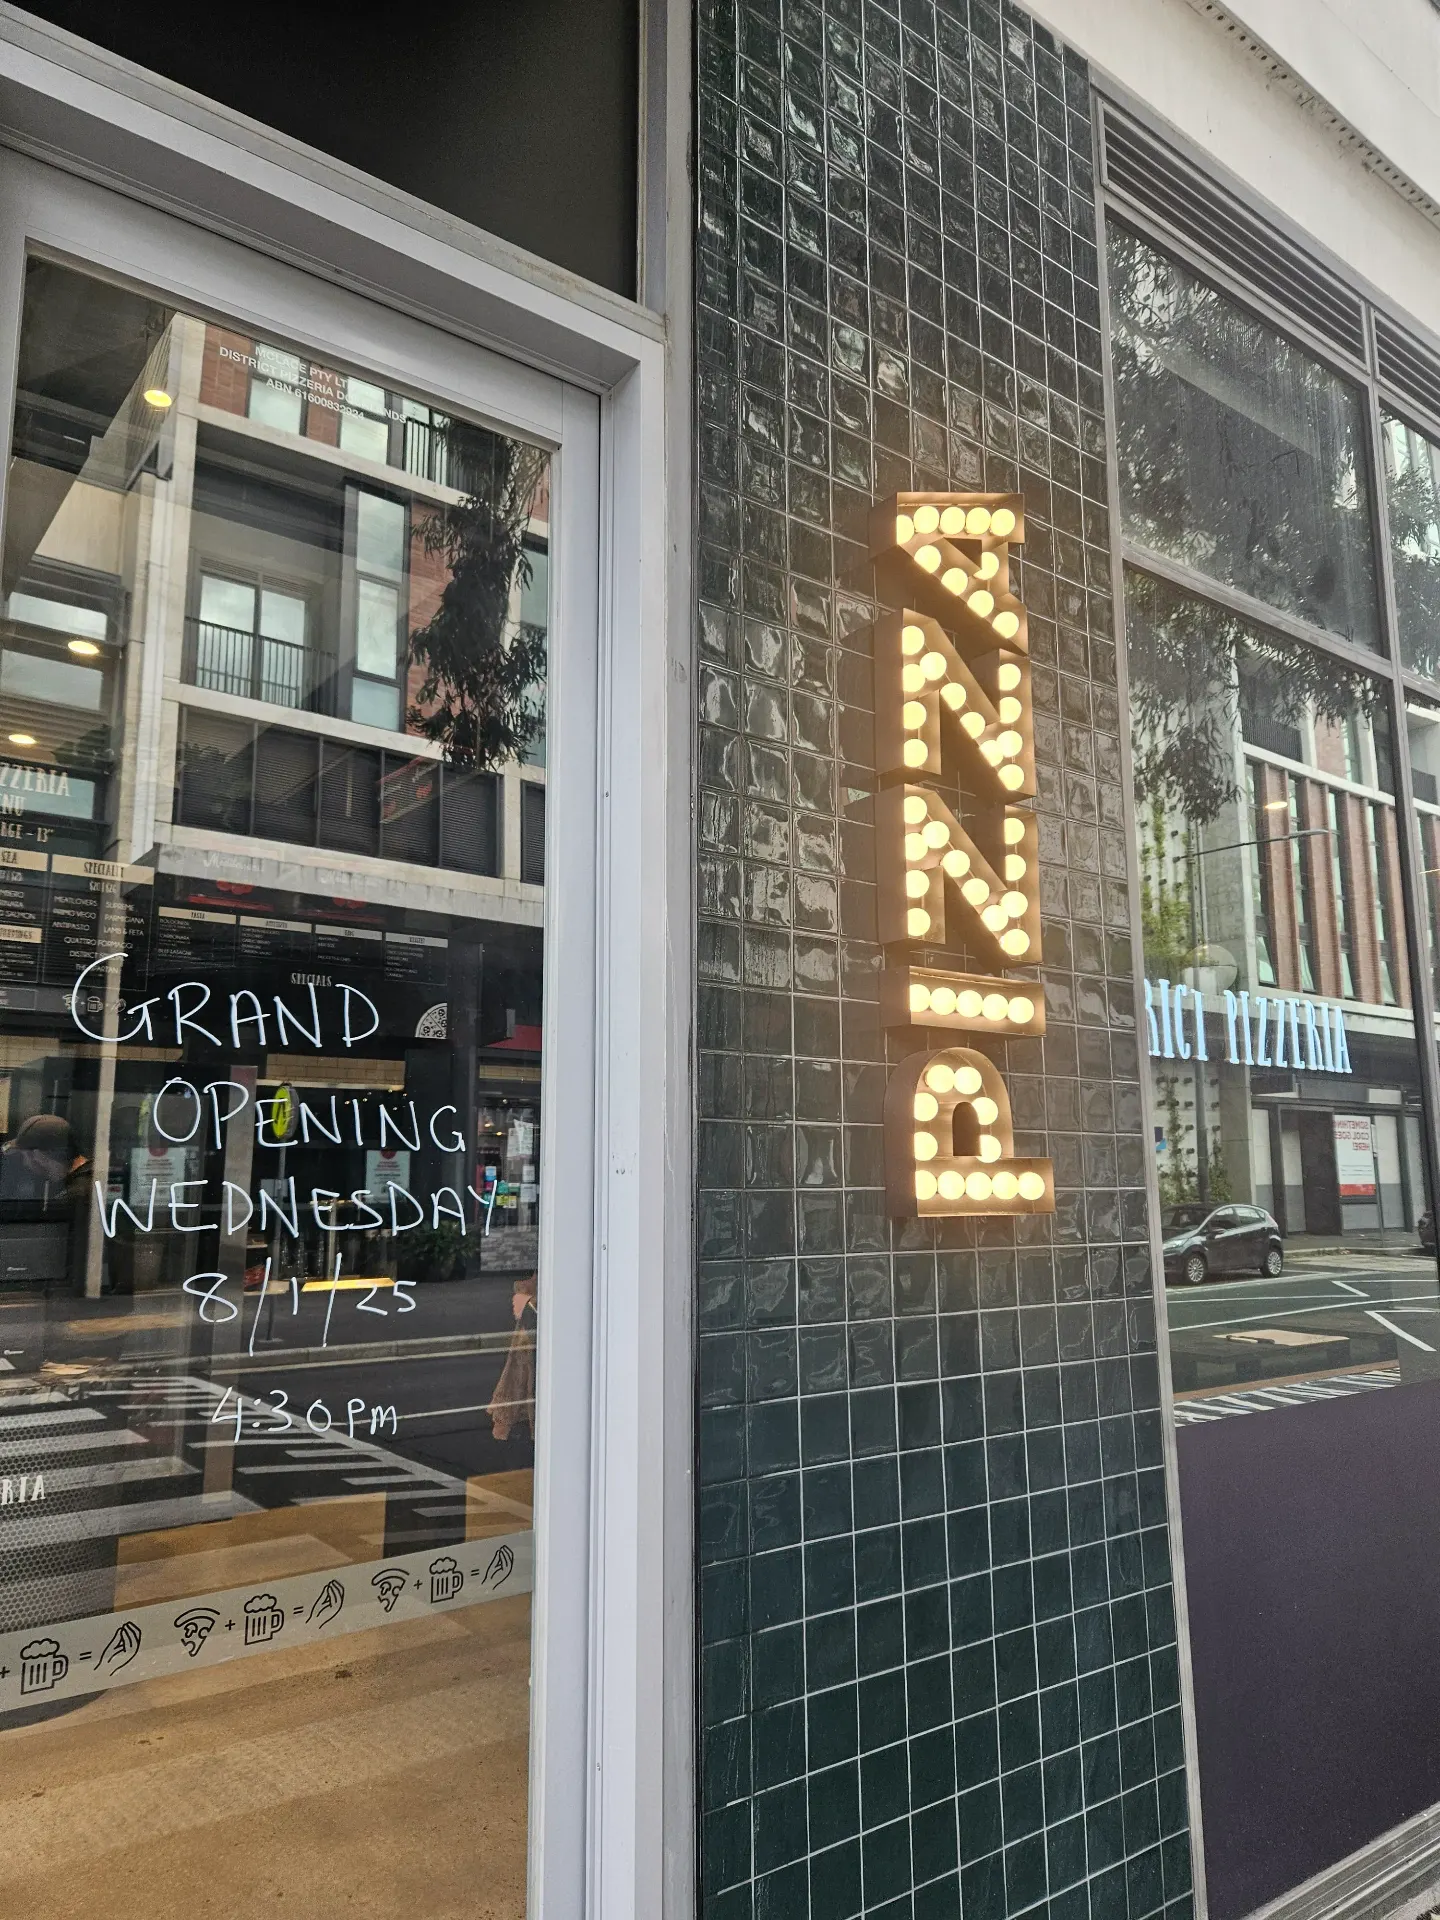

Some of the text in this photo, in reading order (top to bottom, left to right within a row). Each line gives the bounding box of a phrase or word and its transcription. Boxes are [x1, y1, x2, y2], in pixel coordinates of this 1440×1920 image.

[219, 346, 277, 379] DISTRICT
[280, 369, 334, 398] PIZZERIA
[255, 346, 307, 373] MCLACE
[309, 363, 333, 385] PTY
[266, 377, 365, 420] ABN 61600832924
[886, 491, 1056, 1218] PIZZA
[71, 952, 380, 1048] GRAND
[1223, 989, 1353, 1074] PIZZERIA
[152, 1076, 467, 1153] OPENING
[95, 1176, 498, 1238] WEDNESDAY
[182, 1252, 417, 1357] 8/1/25
